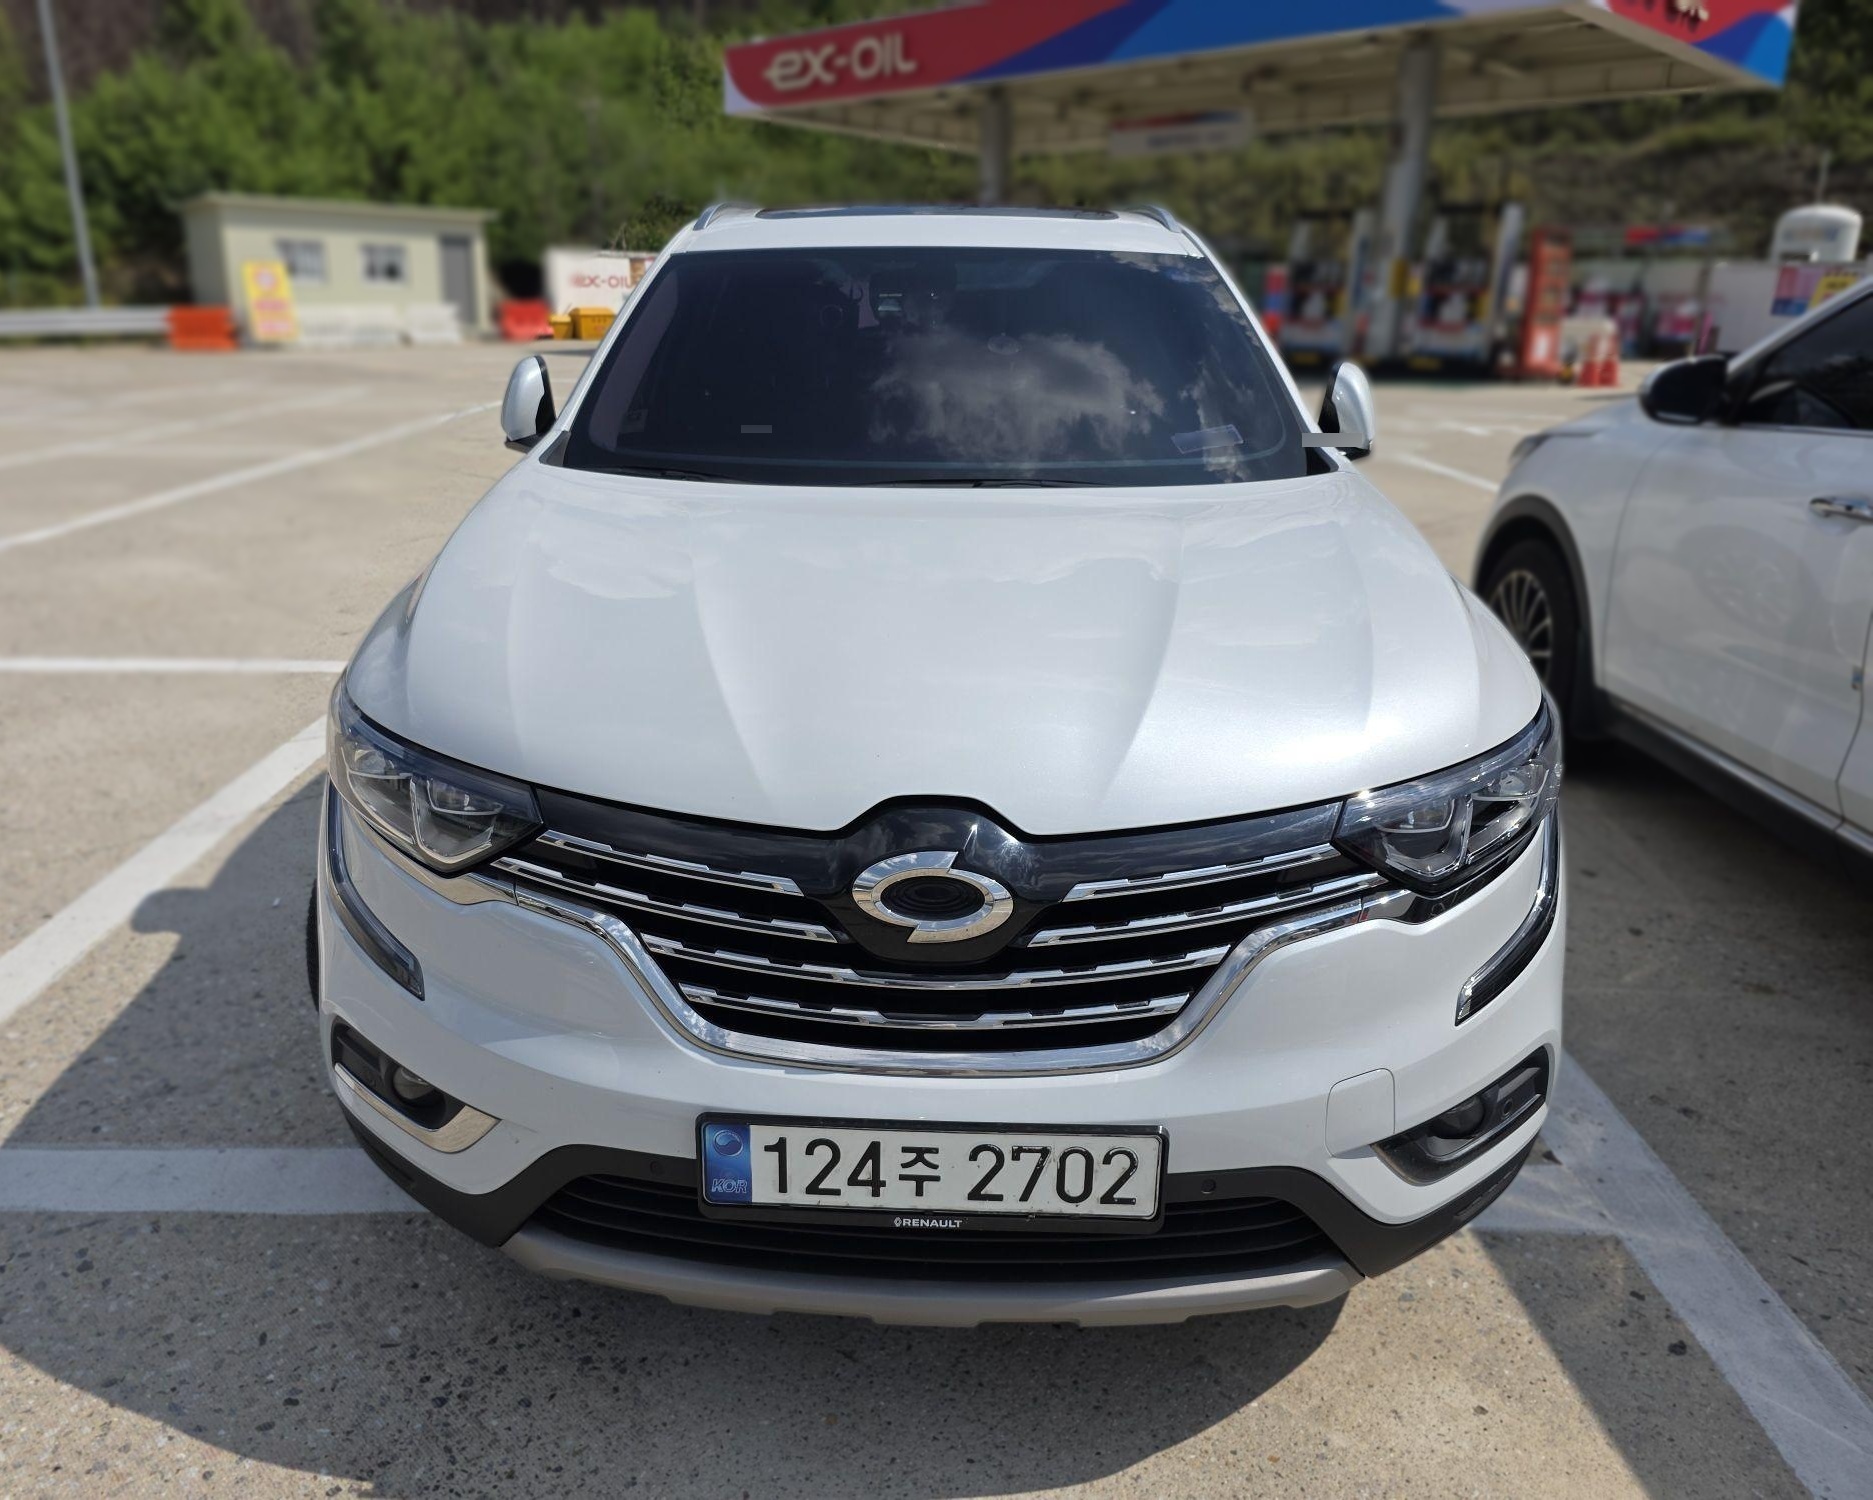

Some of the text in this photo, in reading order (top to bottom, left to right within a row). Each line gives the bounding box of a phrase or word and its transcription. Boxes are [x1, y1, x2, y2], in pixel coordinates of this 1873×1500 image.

[764, 1137, 1139, 1205] 124주 2702
[711, 1178, 748, 1193] KOR
[902, 1218, 963, 1228] RENAULT
